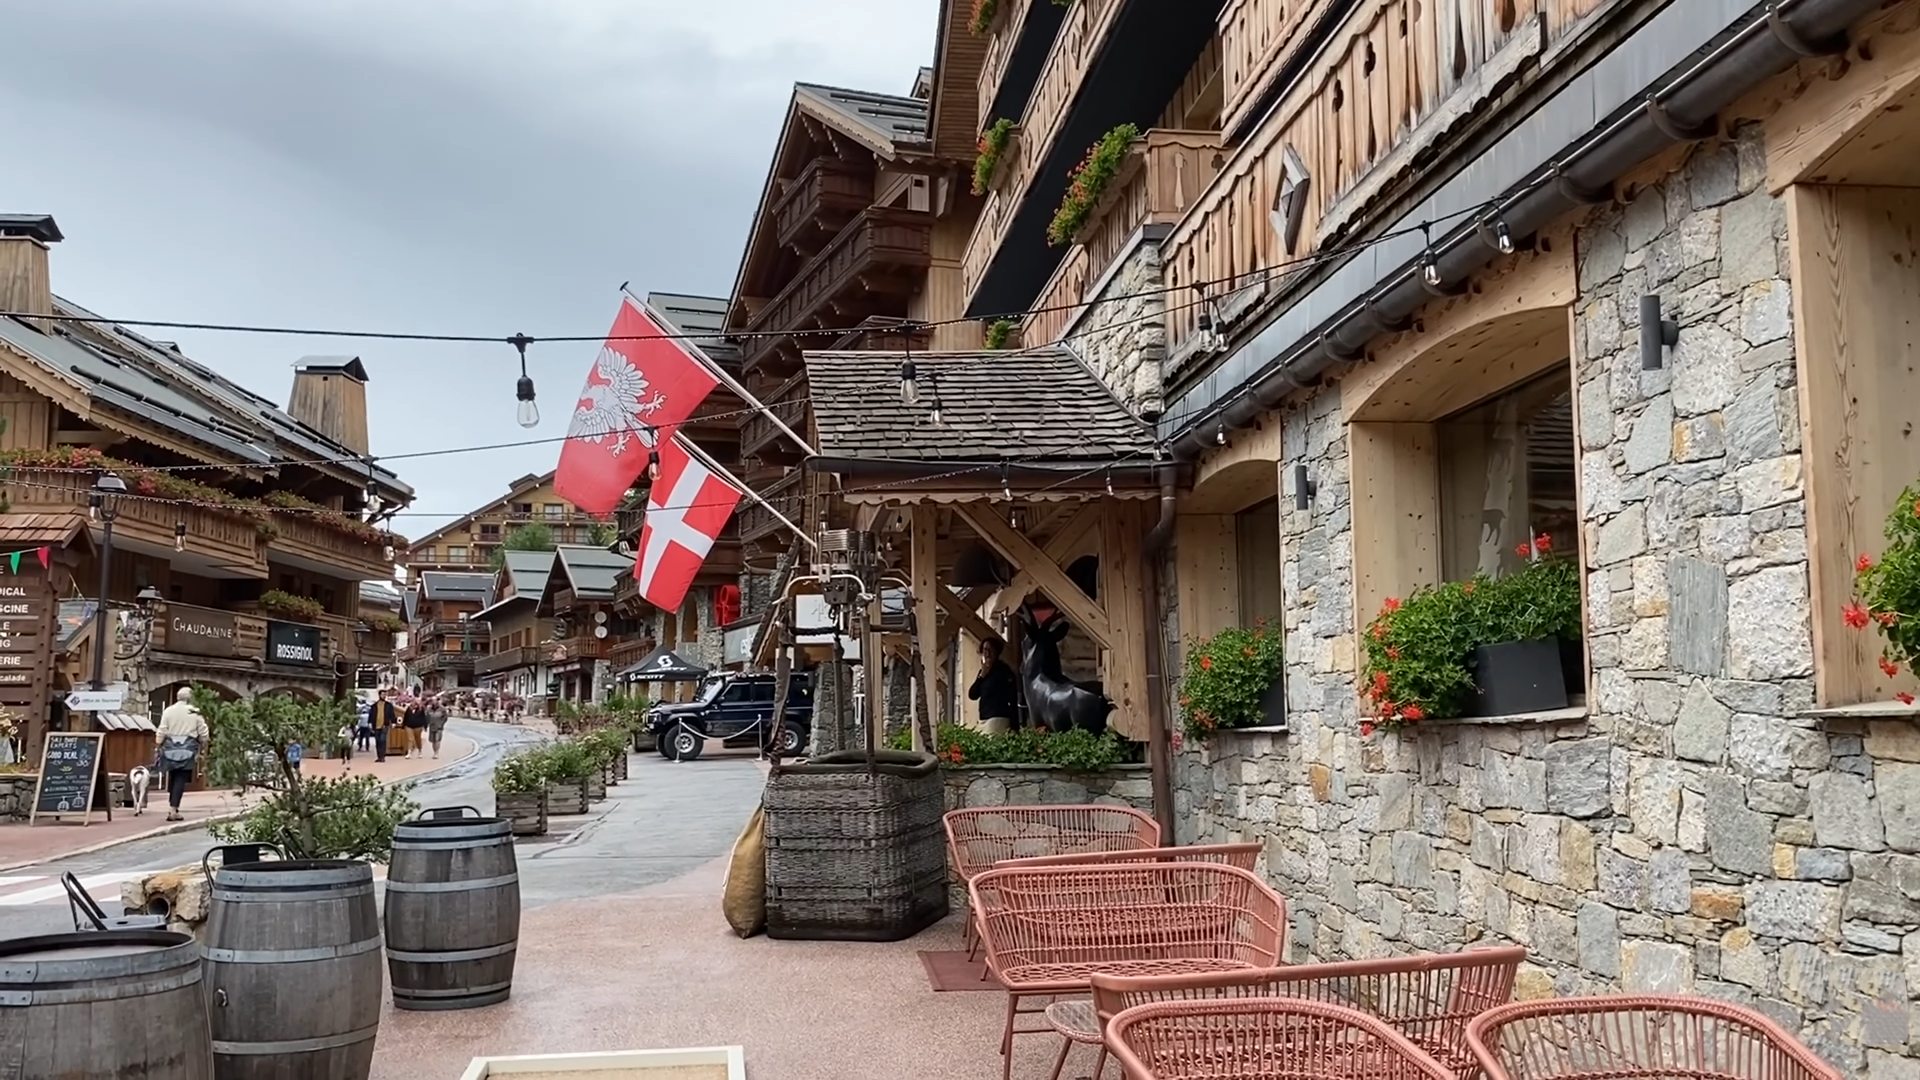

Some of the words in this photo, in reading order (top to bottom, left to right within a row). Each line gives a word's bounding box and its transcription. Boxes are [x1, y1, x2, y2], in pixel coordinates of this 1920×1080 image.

[173, 617, 233, 638] CHAUDANNE
[276, 644, 314, 661] ROSSIGNOL
[47, 751, 62, 759] GOOD
[63, 751, 78, 759] DEAL
